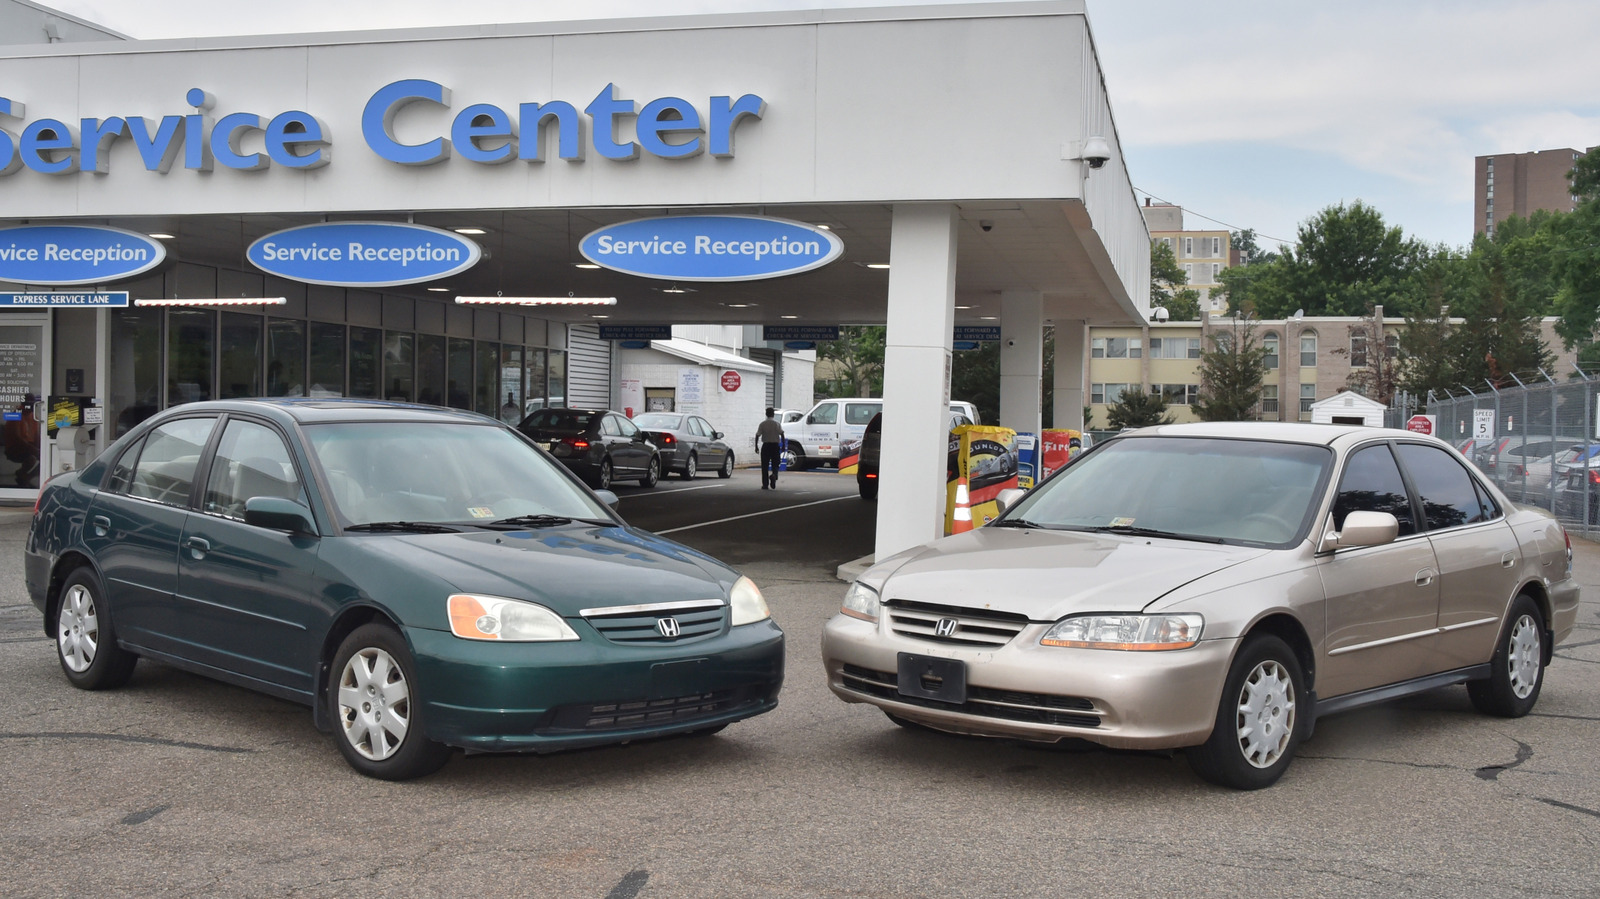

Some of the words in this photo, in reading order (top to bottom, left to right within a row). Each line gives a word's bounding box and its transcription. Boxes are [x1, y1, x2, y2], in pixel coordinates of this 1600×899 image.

[0, 87, 328, 175] ervice
[362, 79, 765, 165] Center
[45, 244, 146, 266] Reception
[263, 243, 341, 261] Service
[349, 243, 460, 266] Reception
[598, 236, 686, 255] Service
[695, 236, 819, 261] Reception
[13, 295, 48, 304] EXPRESS
[51, 295, 86, 304] SERVICE
[88, 295, 110, 304] LANE
[1480, 423, 1487, 433] 5
